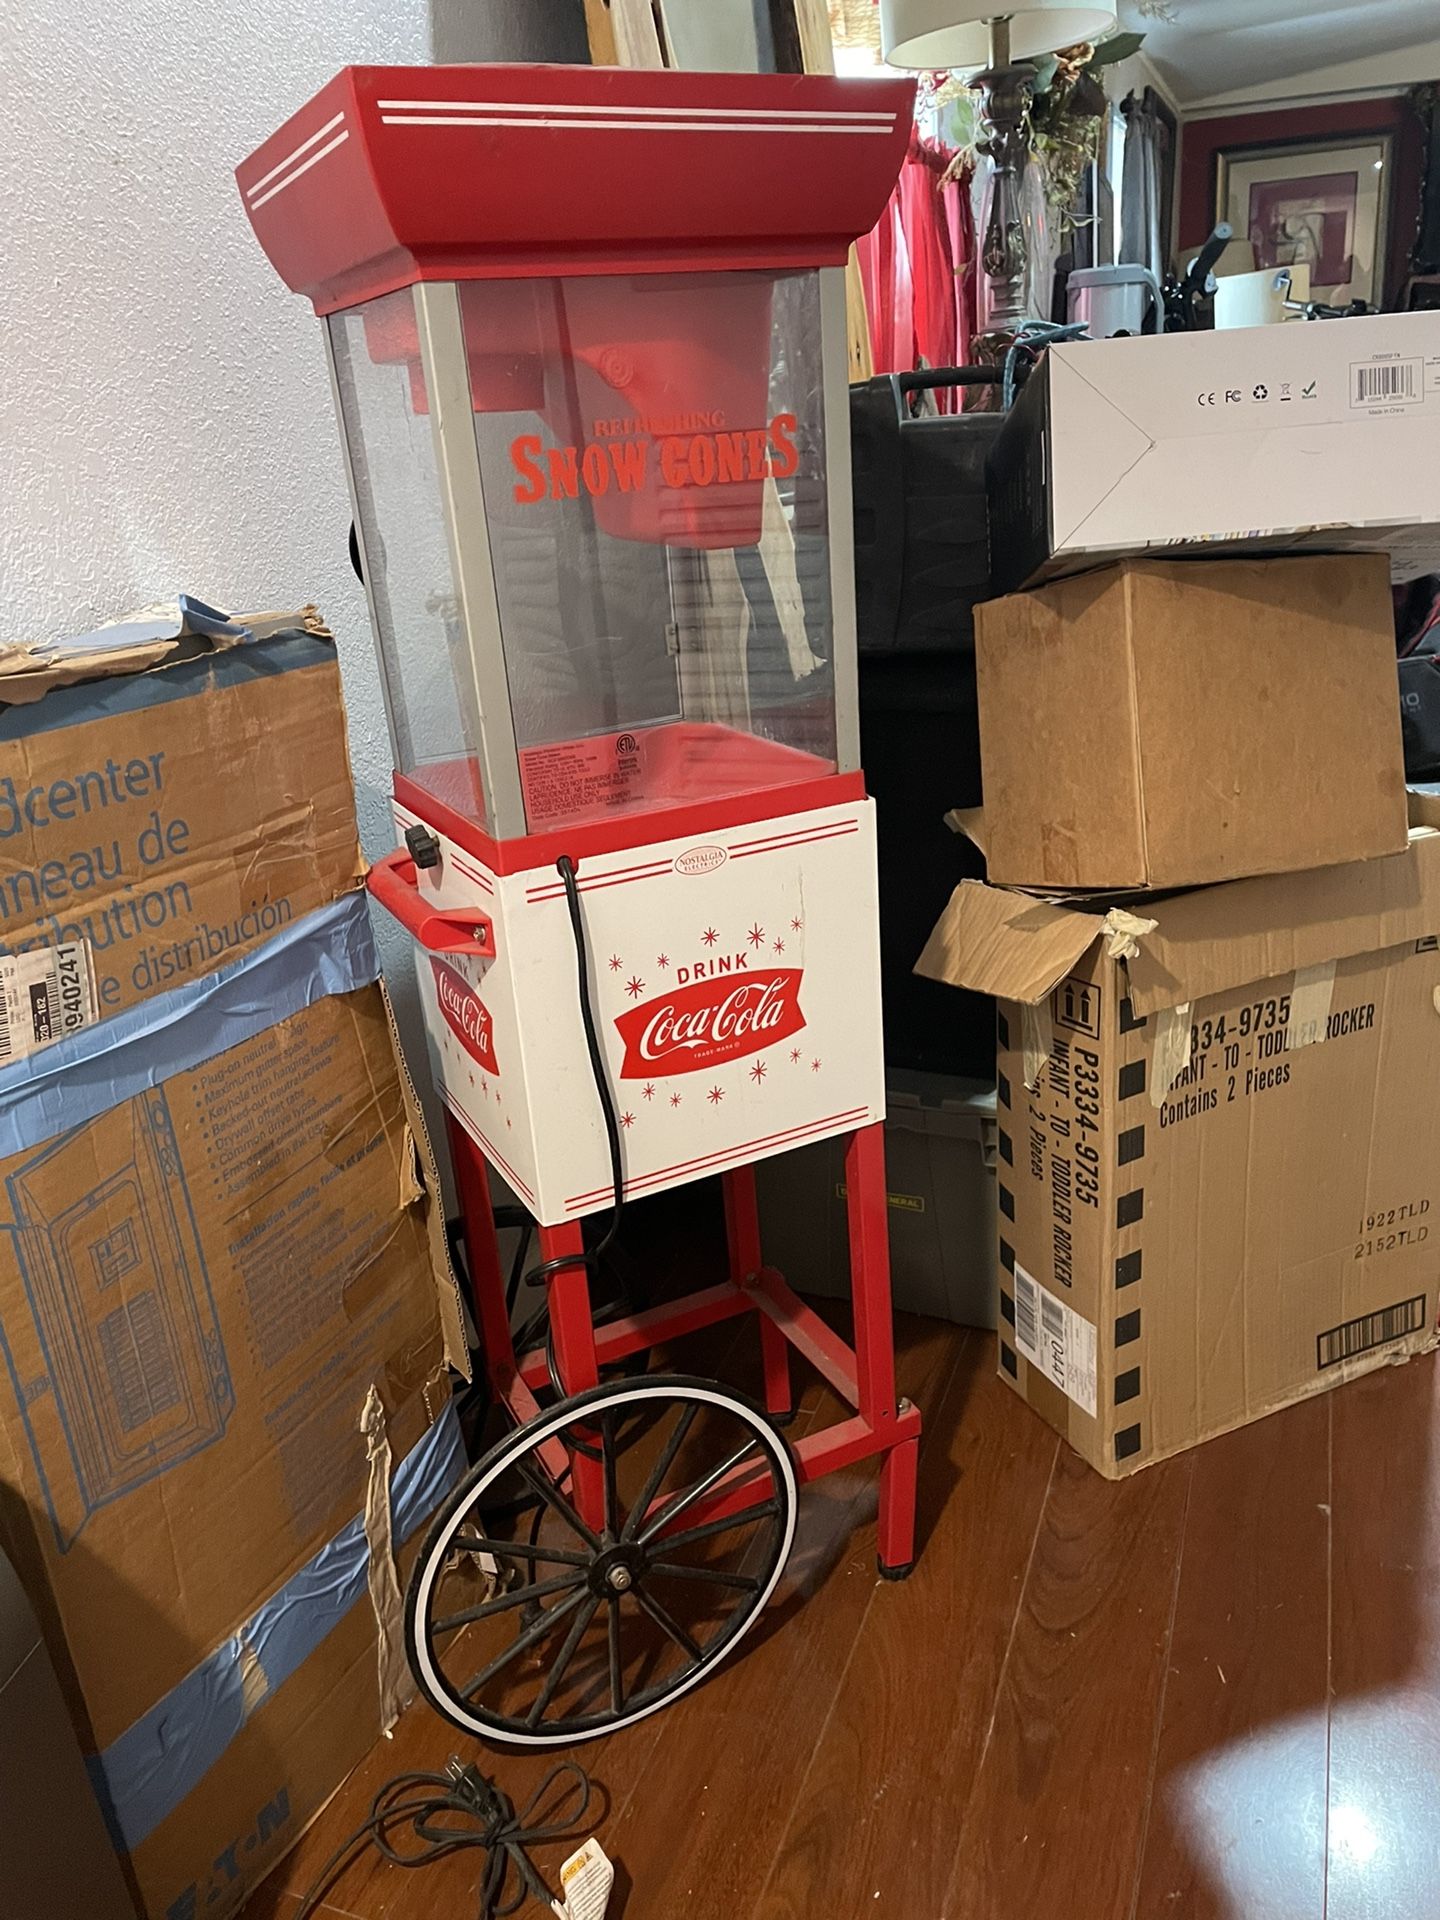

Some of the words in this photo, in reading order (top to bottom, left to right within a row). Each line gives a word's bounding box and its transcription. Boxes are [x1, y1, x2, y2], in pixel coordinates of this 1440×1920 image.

[511, 435, 649, 504] SNOW
[660, 413, 798, 488] CONES
[138, 811, 189, 864] de
[679, 851, 723, 866] NOSTALGIA
[132, 894, 292, 990] distribución
[677, 952, 748, 984] DRINK
[440, 971, 487, 1054] Coca-Cola
[640, 976, 790, 1061] Coca-Cola
[1190, 996, 1291, 1054] 334-9735
[1224, 1043, 1239, 1071] TO
[1325, 1004, 1375, 1040] ROCKER
[202, 1060, 240, 1088] Plug-on
[243, 1040, 276, 1064] neutral
[205, 1070, 253, 1104] Maximum
[1049, 1038, 1070, 1099] INFANT
[209, 1090, 250, 1121] Keyhole
[1029, 1104, 1046, 1121] 2
[1160, 1088, 1217, 1128] Contains
[1228, 1075, 1236, 1102] 2
[1246, 1063, 1290, 1096] Pieces
[217, 1120, 255, 1150] Drywall
[220, 1132, 265, 1165] Common
[1050, 1114, 1070, 1137] TO
[1074, 1046, 1099, 1208] P3334-9735
[1030, 1126, 1047, 1180] Pieces
[889, 1196, 920, 1208] NERAL
[1051, 1153, 1071, 1225] TODDLER
[1053, 1224, 1072, 1288] ROCKER
[1354, 1226, 1429, 1259] 2152TLD
